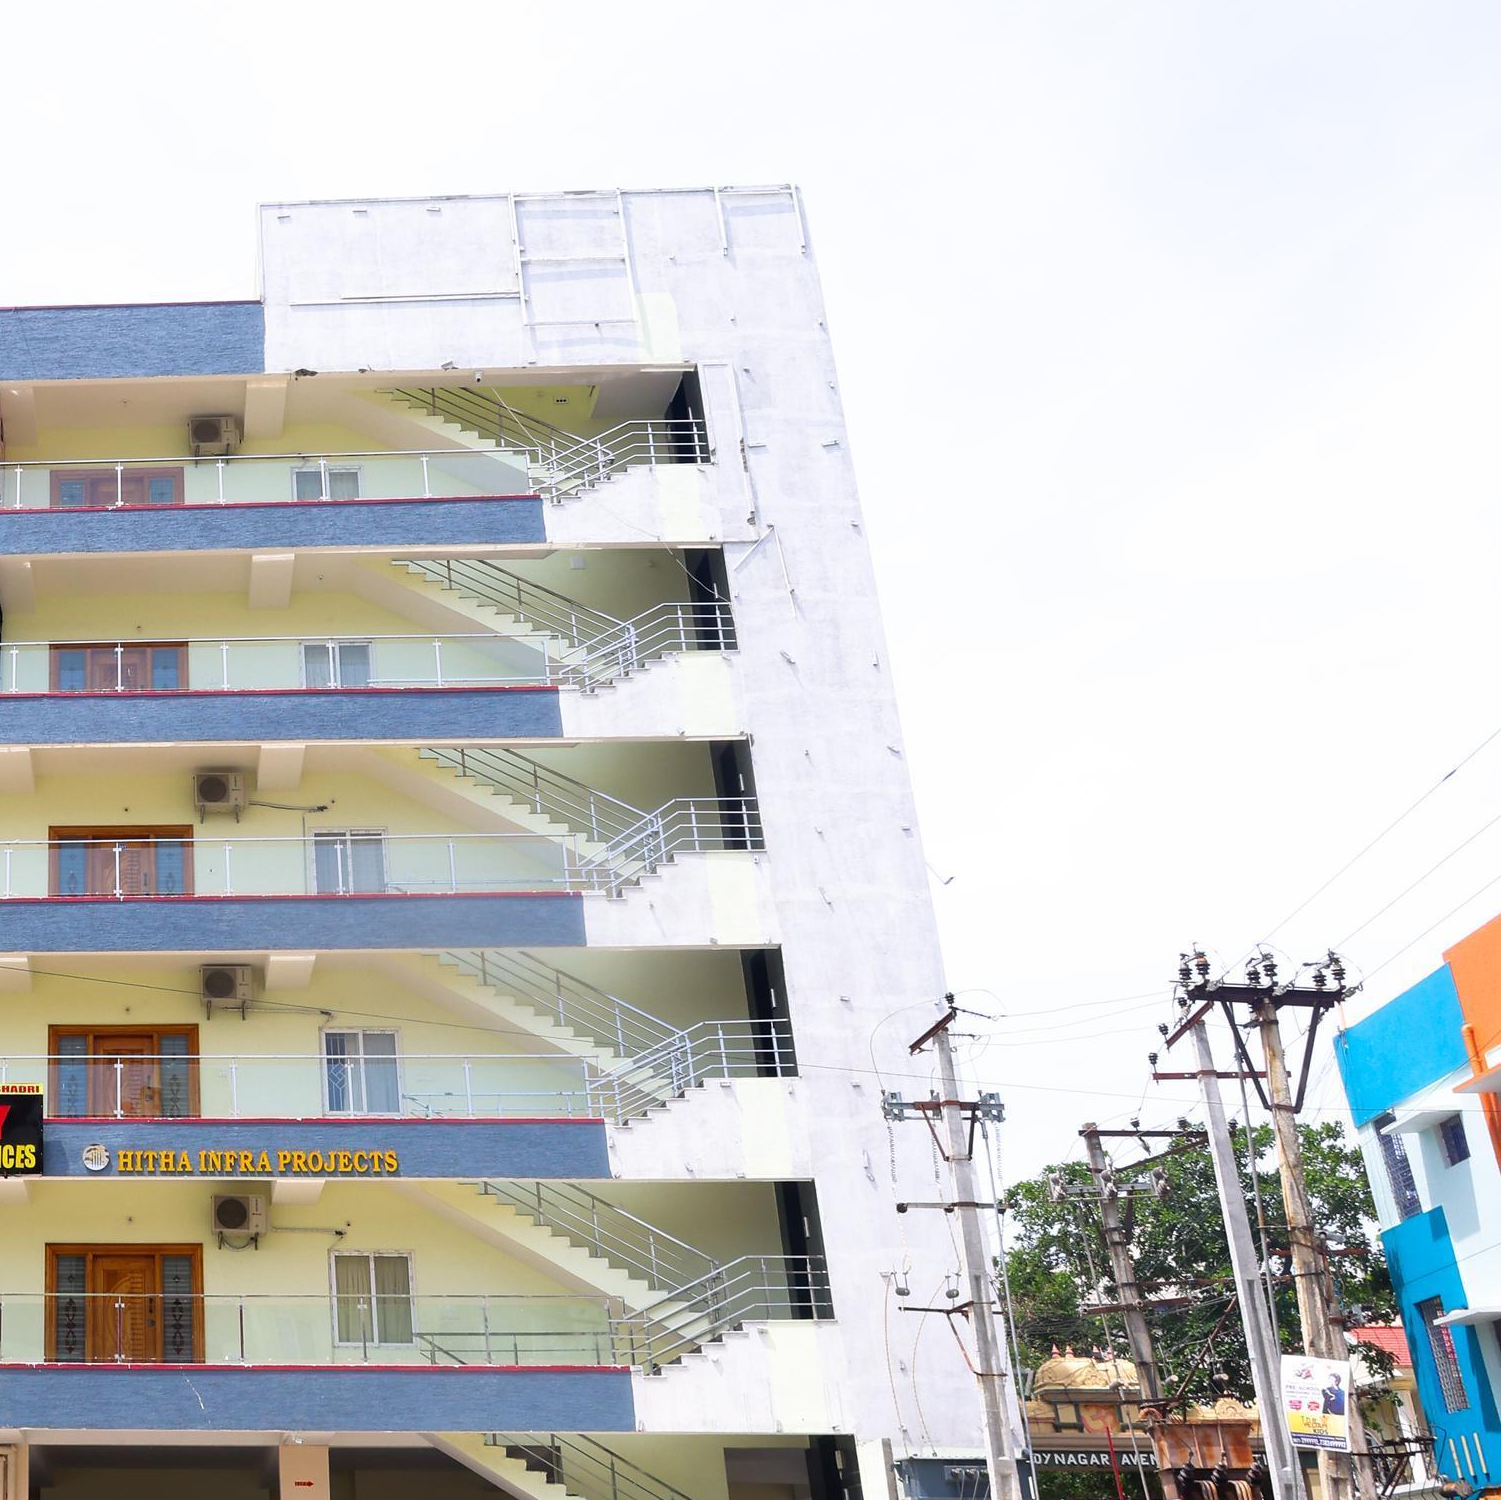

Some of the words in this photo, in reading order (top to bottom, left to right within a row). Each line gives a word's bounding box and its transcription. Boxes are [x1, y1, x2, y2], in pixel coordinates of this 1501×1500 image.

[117, 1150, 193, 1172] HITHA
[199, 1150, 272, 1172] INFRA
[278, 1149, 399, 1173] PROJECTS
